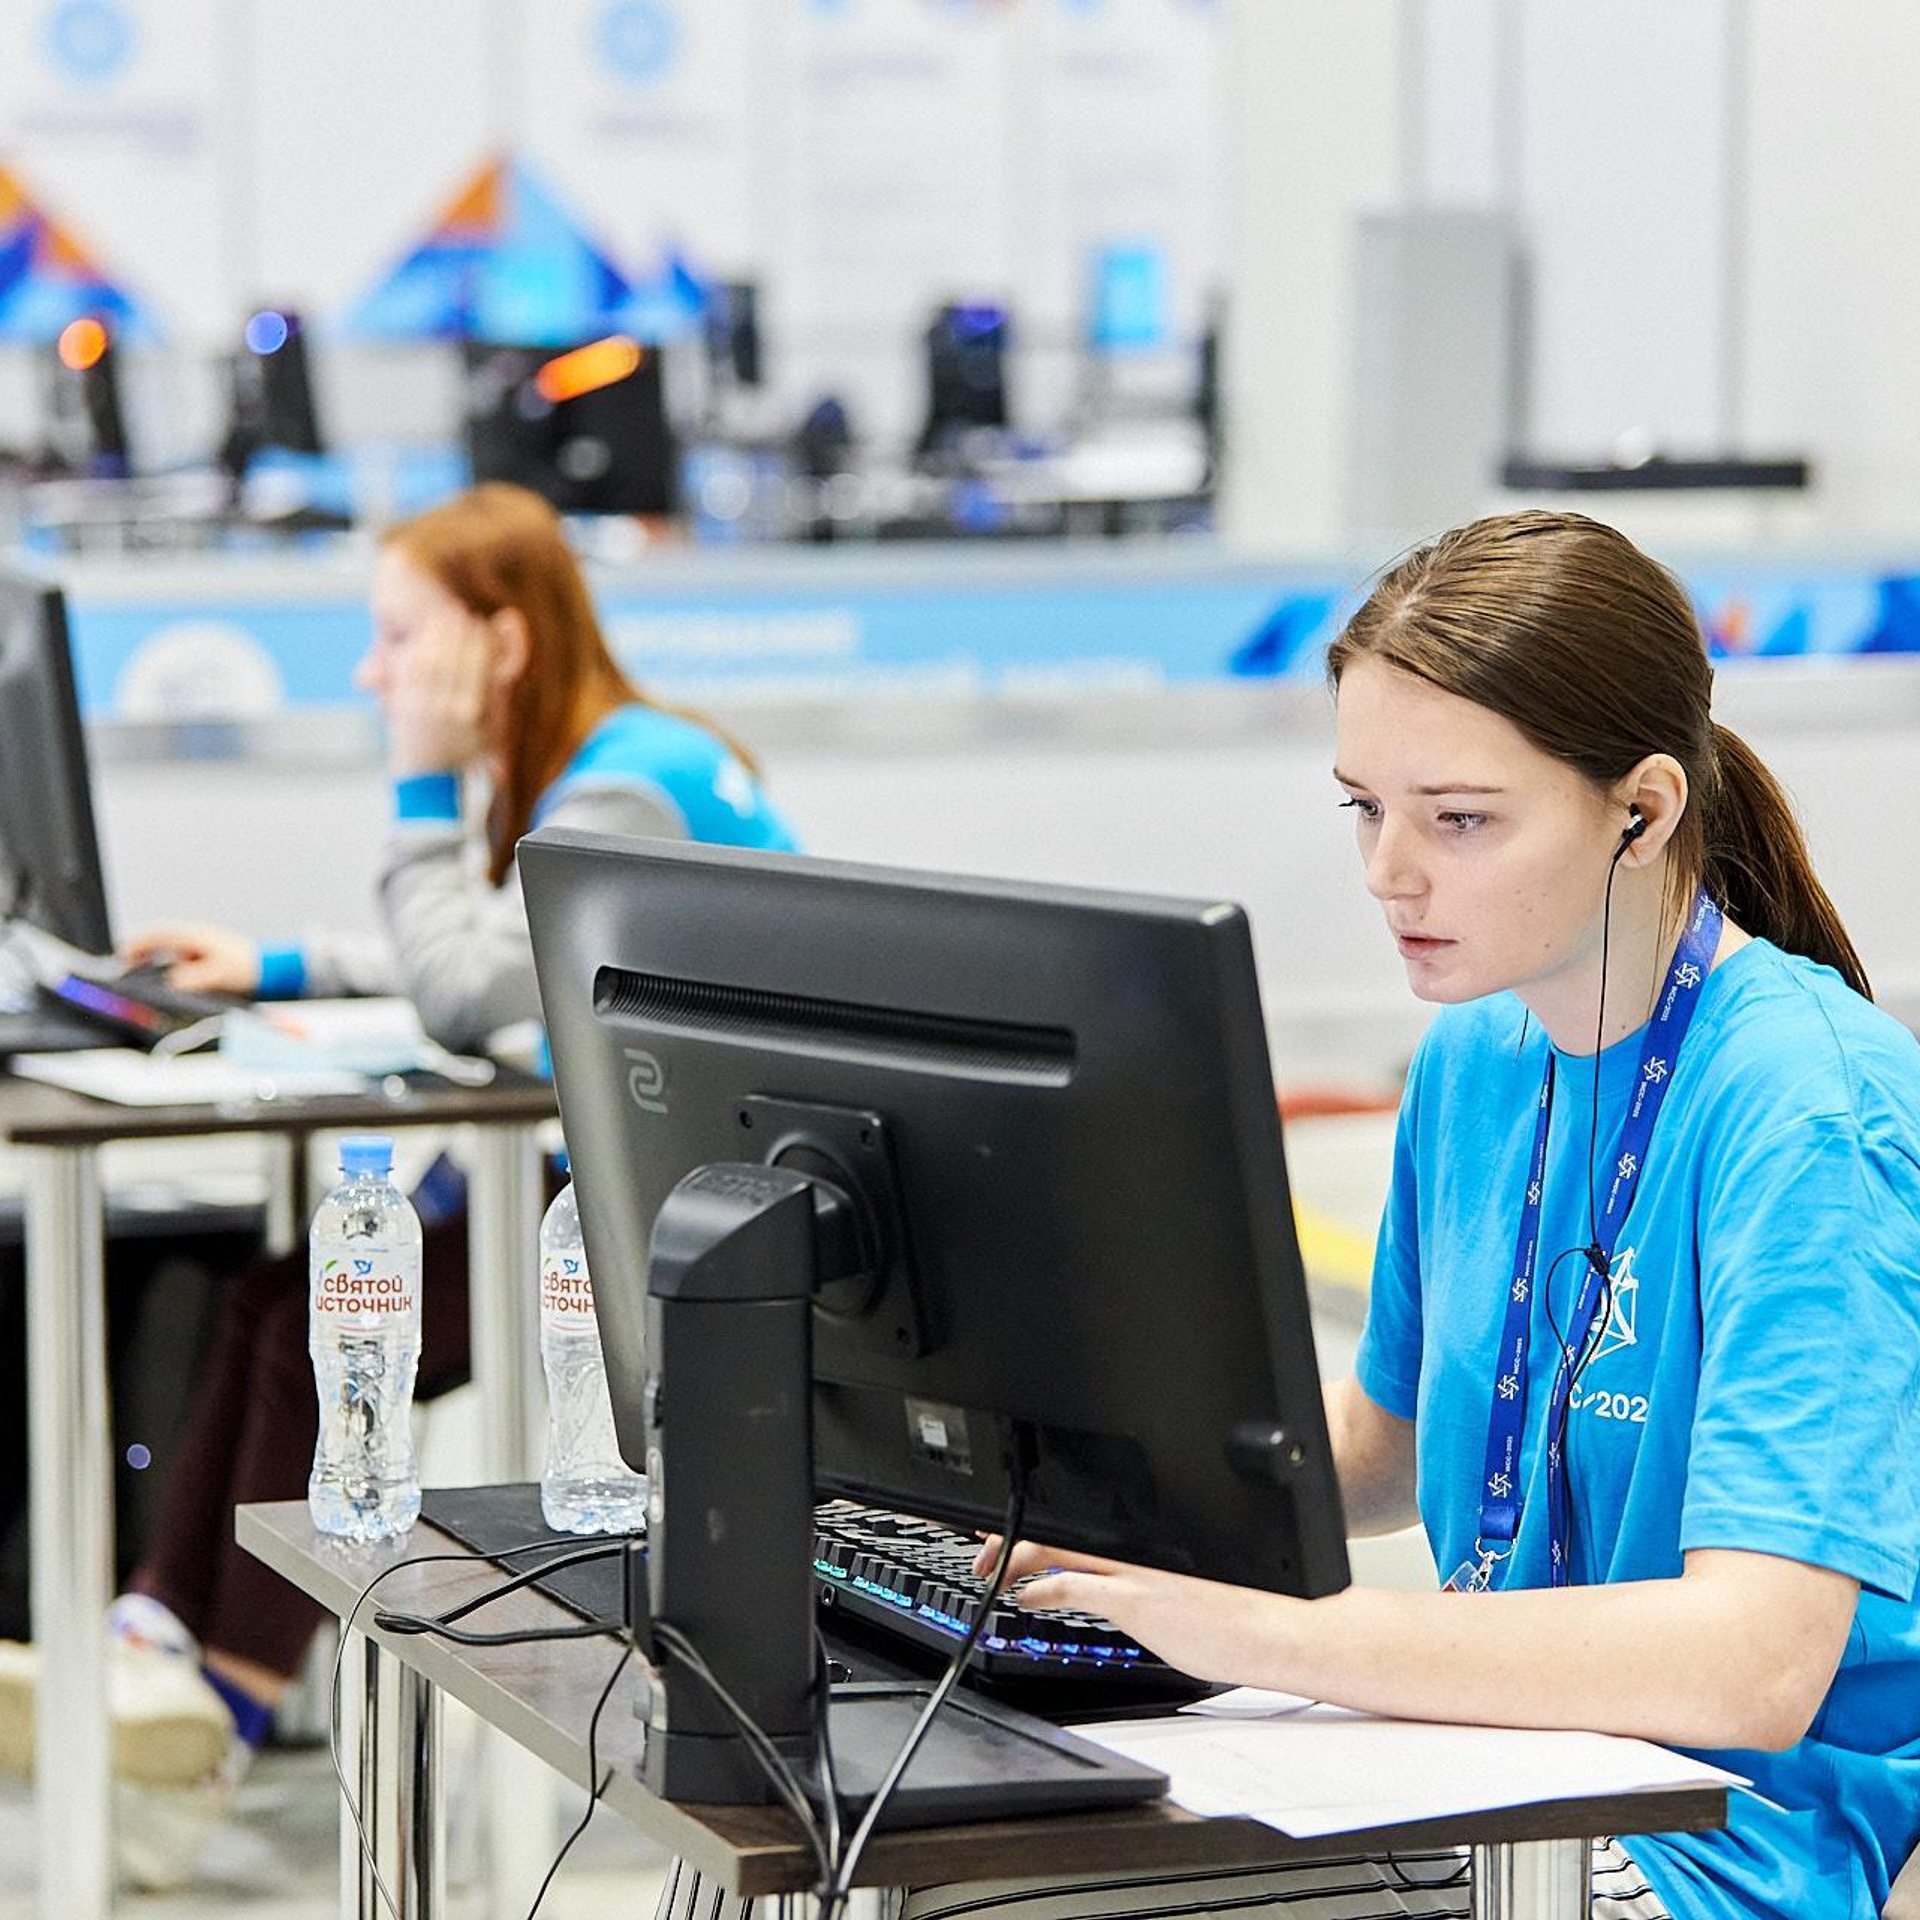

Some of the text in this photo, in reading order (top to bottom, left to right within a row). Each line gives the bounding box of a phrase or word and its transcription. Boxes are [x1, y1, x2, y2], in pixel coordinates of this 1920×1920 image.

[543, 1271, 592, 1294] свято
[542, 1295, 595, 1313] сточн
[1569, 1382, 1649, 1423] C/202
